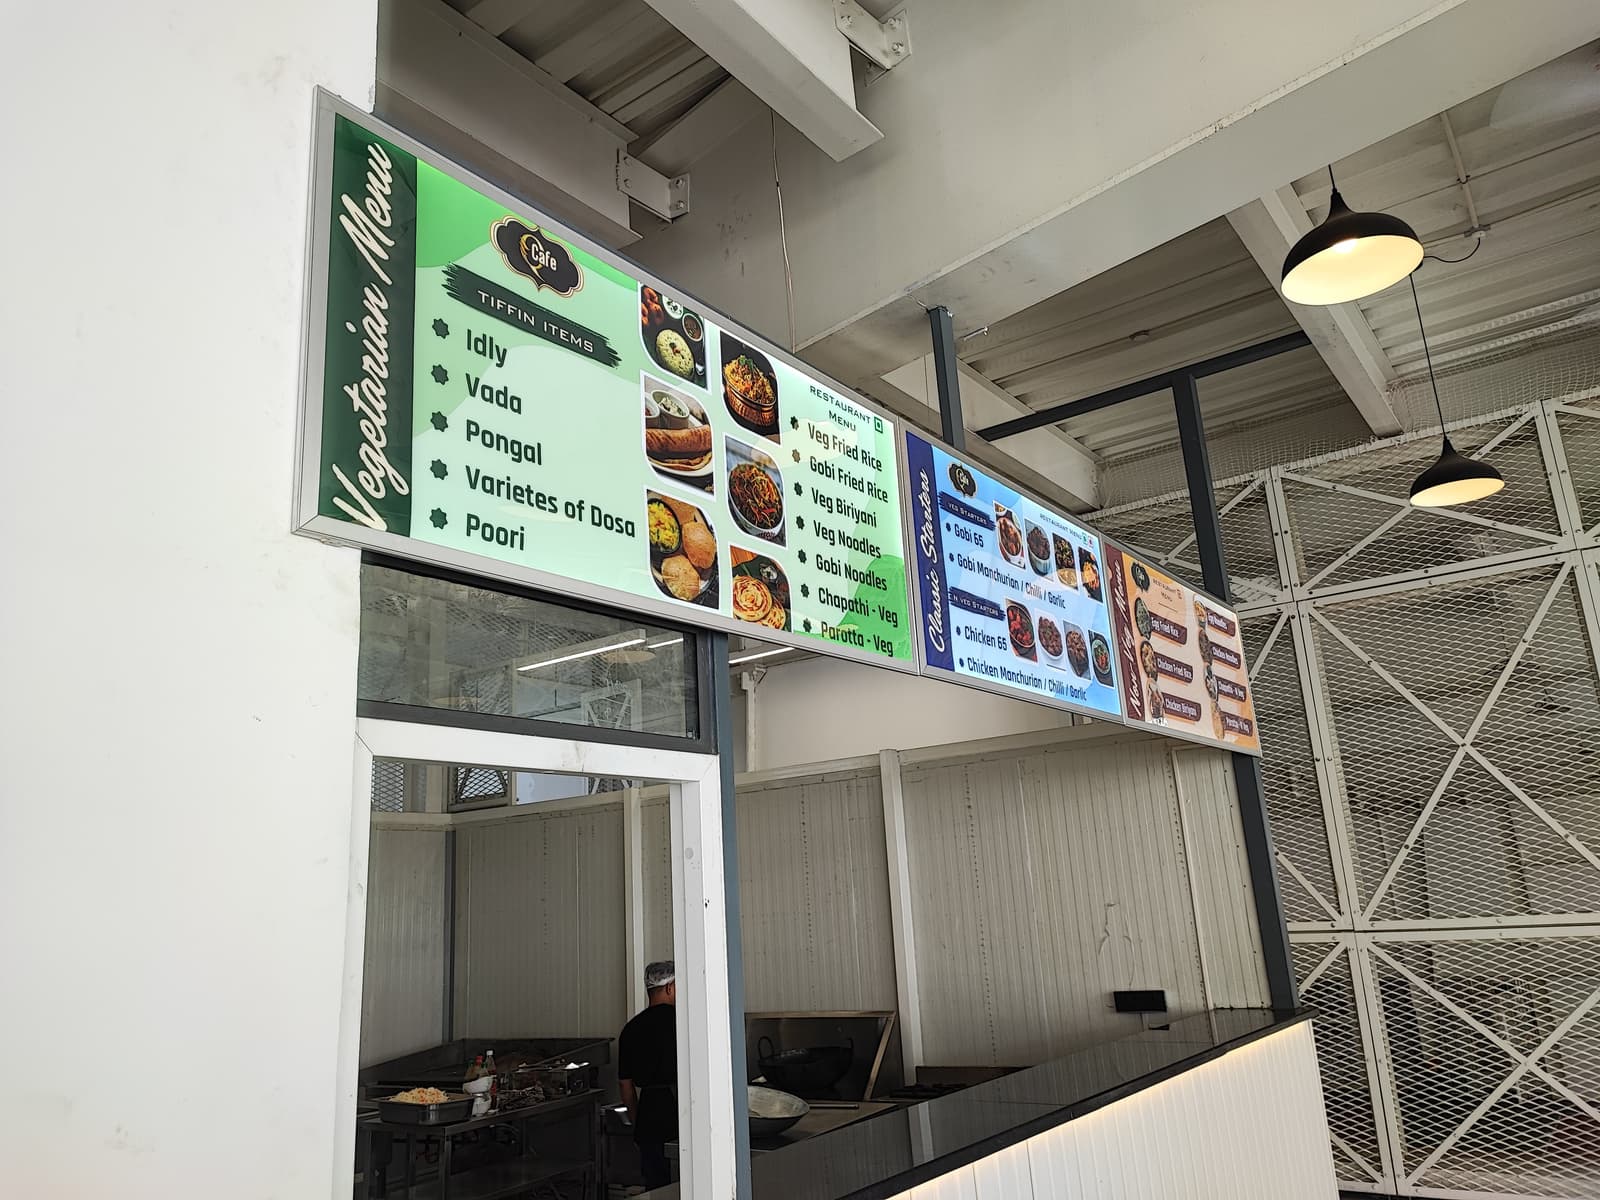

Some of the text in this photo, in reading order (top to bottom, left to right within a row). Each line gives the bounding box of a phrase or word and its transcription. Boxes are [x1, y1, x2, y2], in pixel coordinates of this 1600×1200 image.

[531, 243, 558, 271] Cafe
[332, 142, 411, 531] Vegetarian Menu
[478, 288, 594, 354] TIFFIN ITEMS
[466, 328, 508, 368] Idly
[465, 373, 523, 415] Vada
[809, 385, 871, 424] RESTAURANT
[828, 410, 857, 431] MENU
[466, 419, 542, 466] Pongal
[808, 422, 882, 472] Veg Fried Rice
[810, 457, 888, 503] Gobi Fried Rice
[465, 464, 636, 538] Varietes of Dosa
[811, 487, 877, 528] Veg Biriyani
[466, 513, 526, 551] Poori
[813, 520, 881, 559] Veg Noodles
[955, 523, 985, 549] Gobi 65
[815, 554, 888, 591] Gobi Noodles
[920, 468, 945, 653] Classic Starters
[957, 552, 974, 572] Gobi
[977, 564, 1019, 591] Manchurian
[1025, 582, 1042, 600] Chilli
[1048, 591, 1066, 609] Garlic
[818, 587, 869, 617] Chapathi
[878, 605, 898, 628] Veg
[821, 621, 864, 647] Parotta
[874, 634, 894, 657] Veg
[965, 626, 1008, 651] Chicken 65
[968, 657, 999, 679] Chicken
[1000, 668, 1043, 690] Manchurian
[1048, 679, 1065, 695] Chilli
[1070, 684, 1088, 701] Garlic
